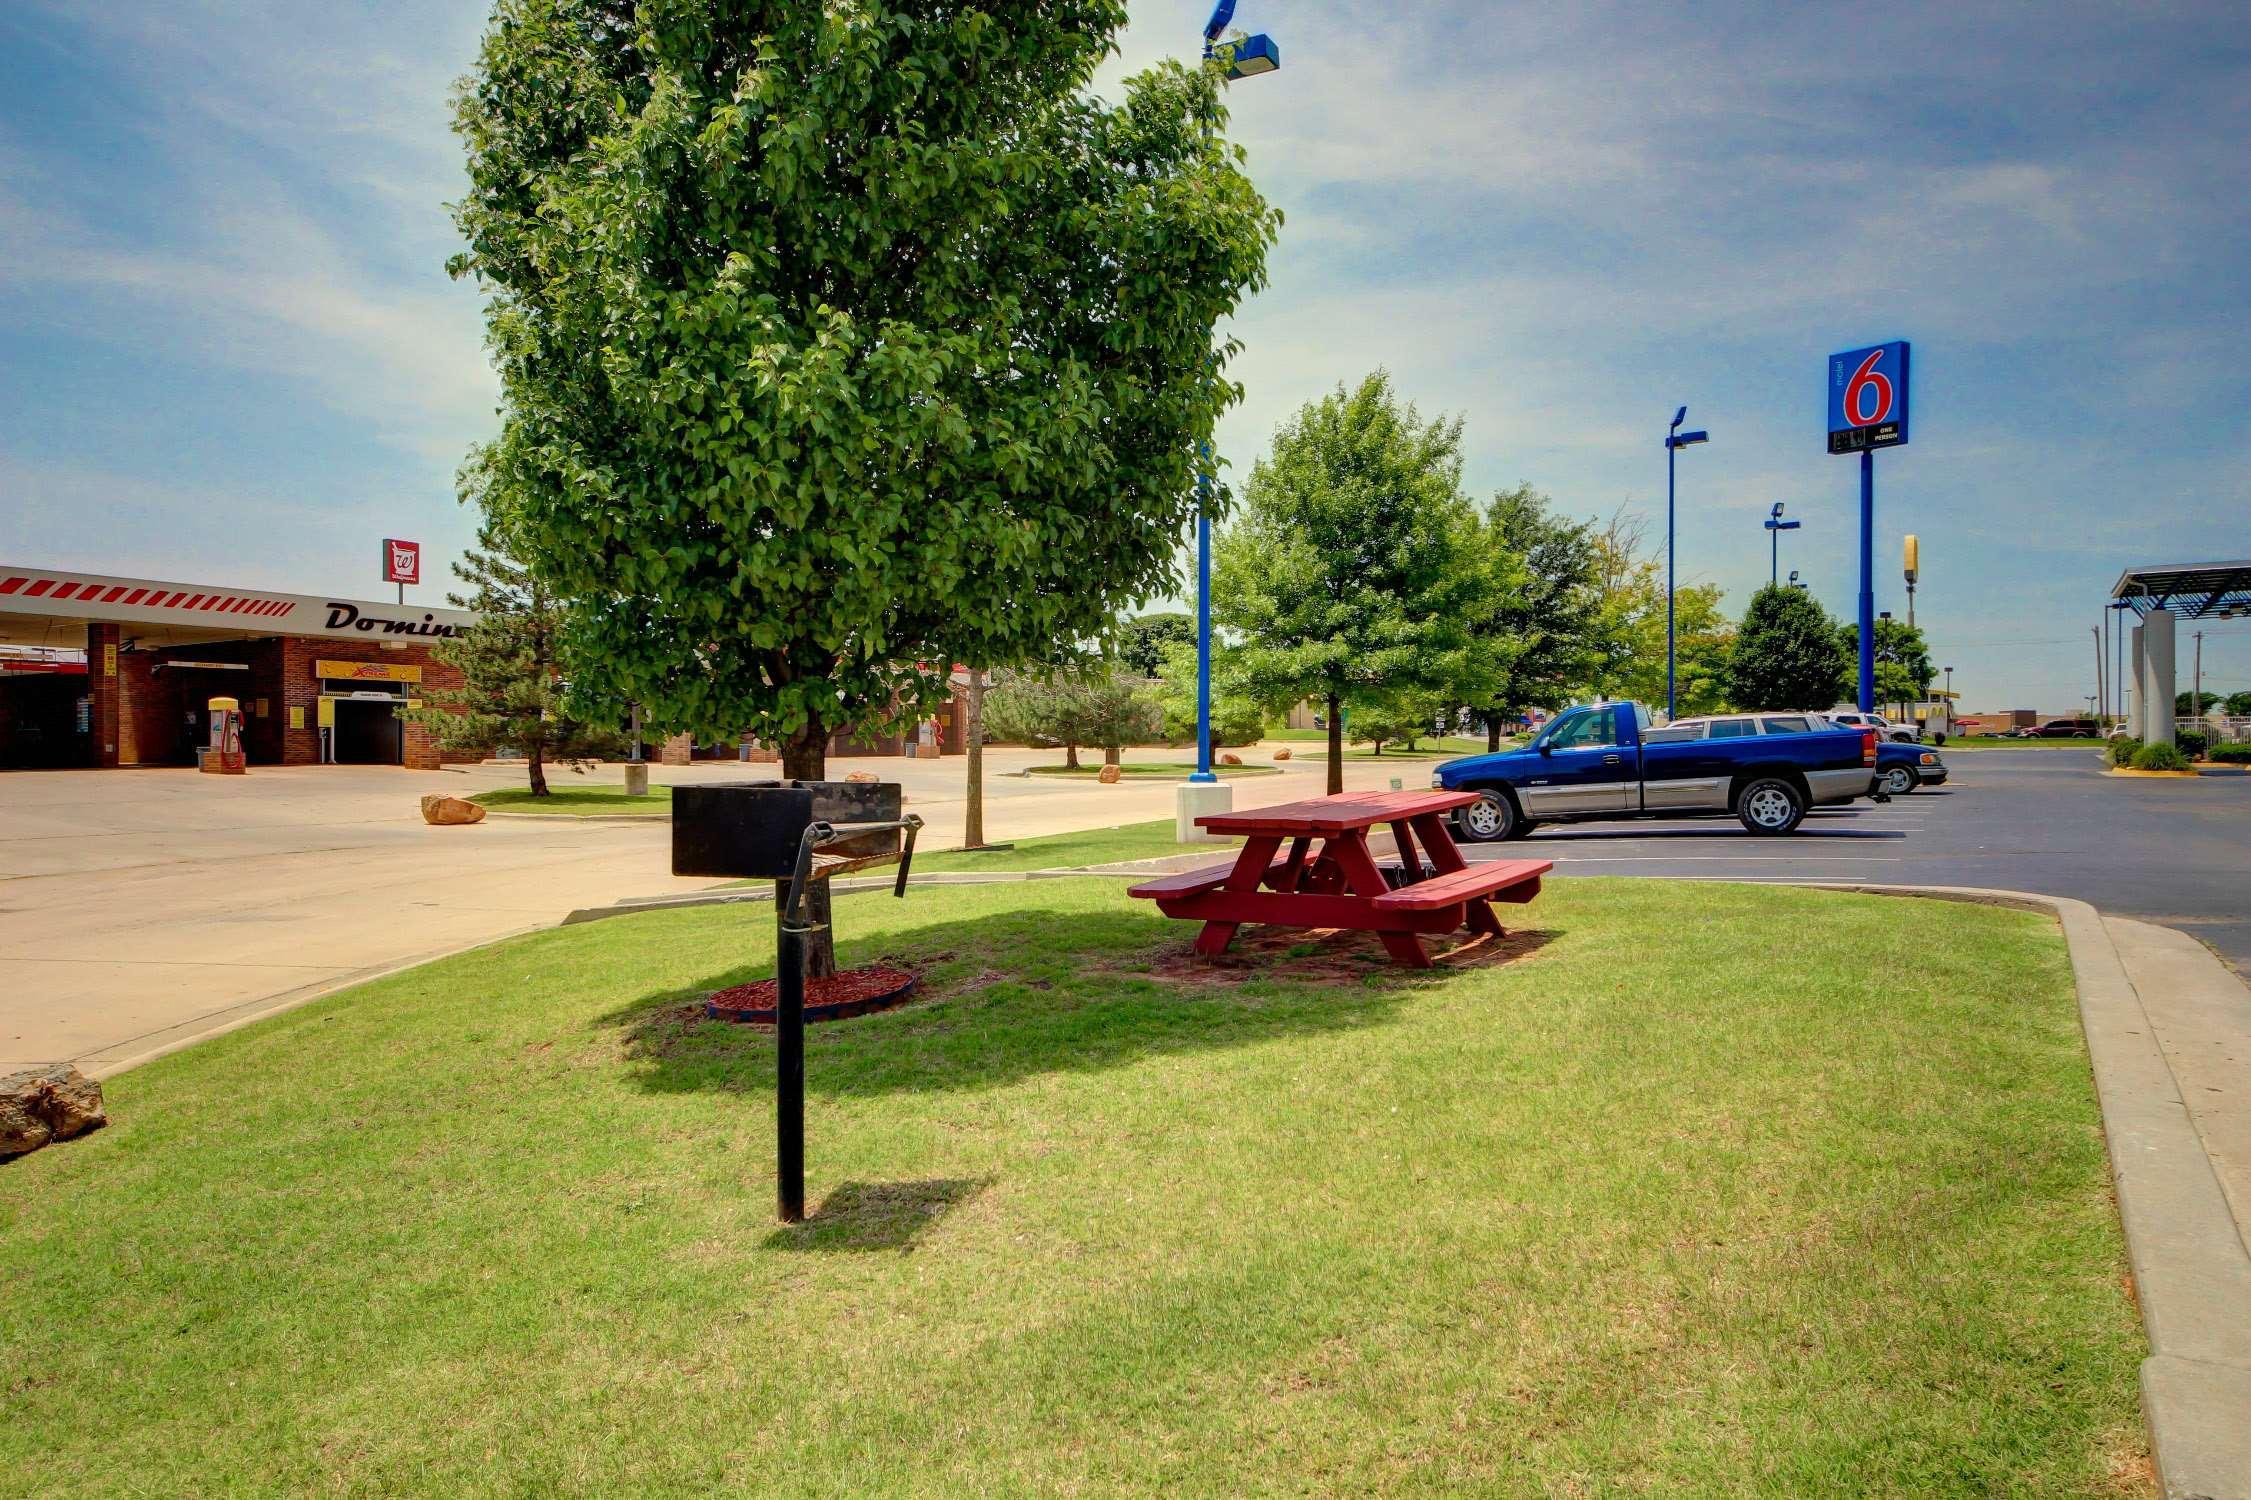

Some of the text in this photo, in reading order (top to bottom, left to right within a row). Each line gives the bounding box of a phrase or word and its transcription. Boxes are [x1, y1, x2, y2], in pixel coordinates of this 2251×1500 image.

[1833, 361, 1844, 386] motel
[1843, 349, 1893, 428] 6
[1874, 432, 1898, 441] PERSON
[1880, 426, 1893, 434] ONE
